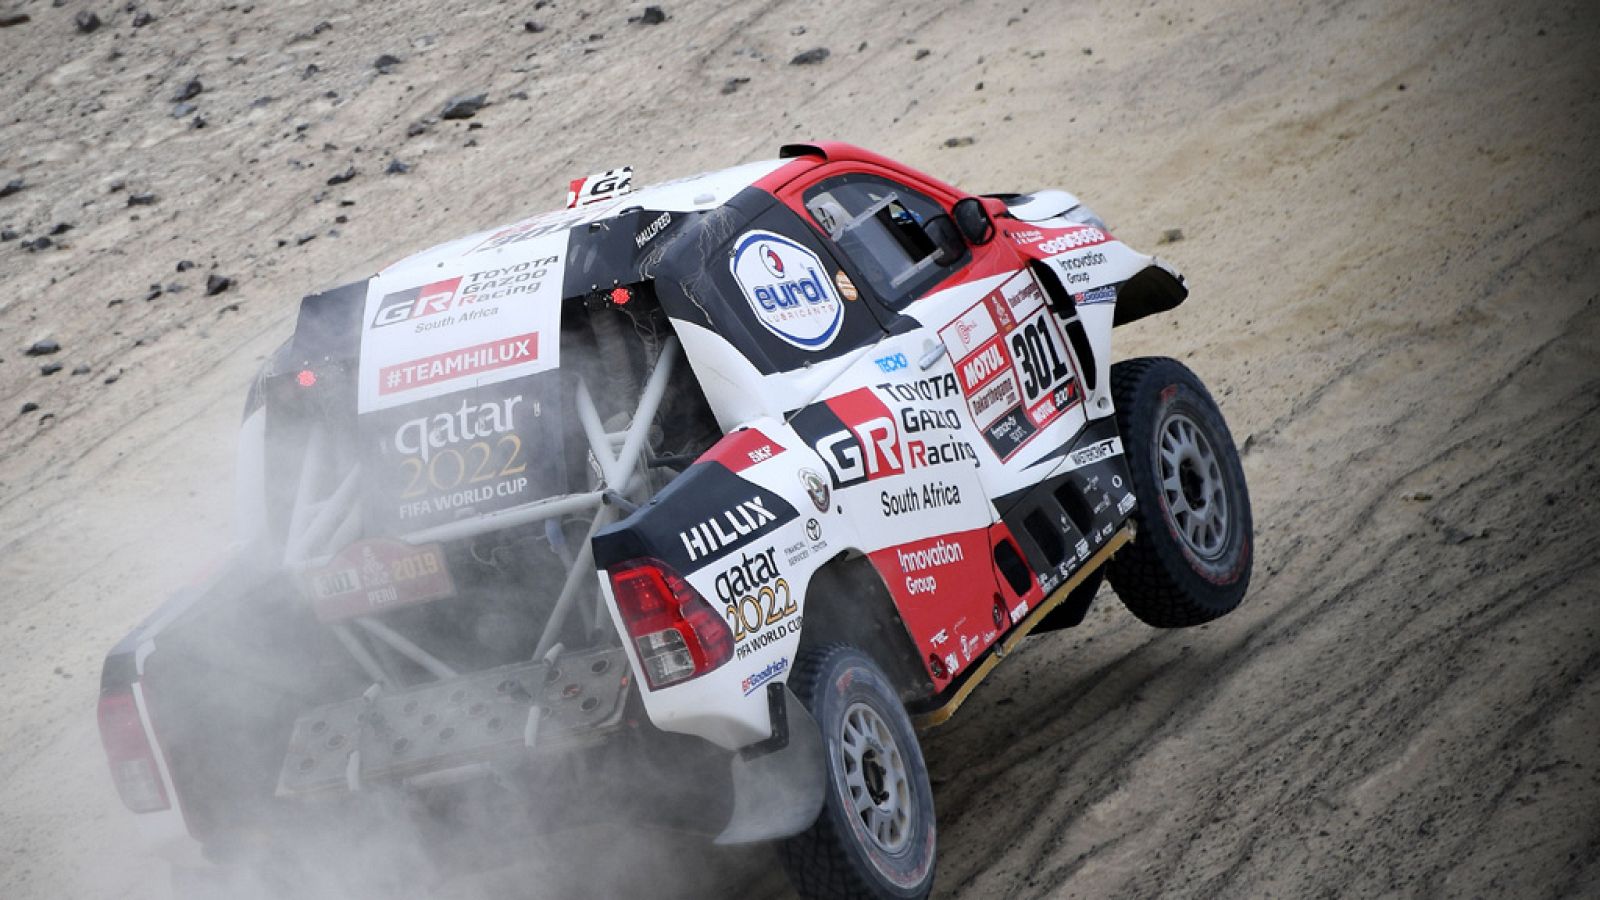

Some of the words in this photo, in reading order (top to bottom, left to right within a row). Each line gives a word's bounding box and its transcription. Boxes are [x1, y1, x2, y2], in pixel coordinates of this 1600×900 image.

[636, 211, 672, 248] HALLSPEED
[469, 255, 559, 282] TOYOTA
[1056, 251, 1107, 271] Innovation
[1067, 272, 1090, 284] Group
[458, 281, 541, 307] Racing
[462, 269, 548, 295] GAZOO
[754, 268, 830, 312] eurol
[415, 314, 456, 333] South
[458, 305, 500, 327] Africa
[386, 339, 531, 388] #TEAMHILUX
[963, 343, 1004, 390] MOTUL
[1012, 314, 1068, 400] 301
[875, 372, 960, 402] TOYOTA
[394, 395, 523, 464] qatar
[401, 434, 527, 498] 2022
[748, 445, 773, 463] SKF
[907, 434, 981, 468] Racing
[400, 503, 432, 520] FIFA
[435, 486, 494, 512] WORLD
[497, 477, 528, 496] CUP
[881, 486, 919, 517] South
[922, 481, 961, 508] Africa
[680, 496, 777, 562] HILUX
[393, 553, 438, 580] 2019
[897, 540, 964, 573] Innovation
[715, 546, 780, 607] qatar
[906, 576, 937, 595] Group
[726, 578, 797, 642] 2022
[736, 642, 752, 661] FIFA
[751, 626, 787, 653] WORLD
[742, 657, 788, 693] BFGoodrich
